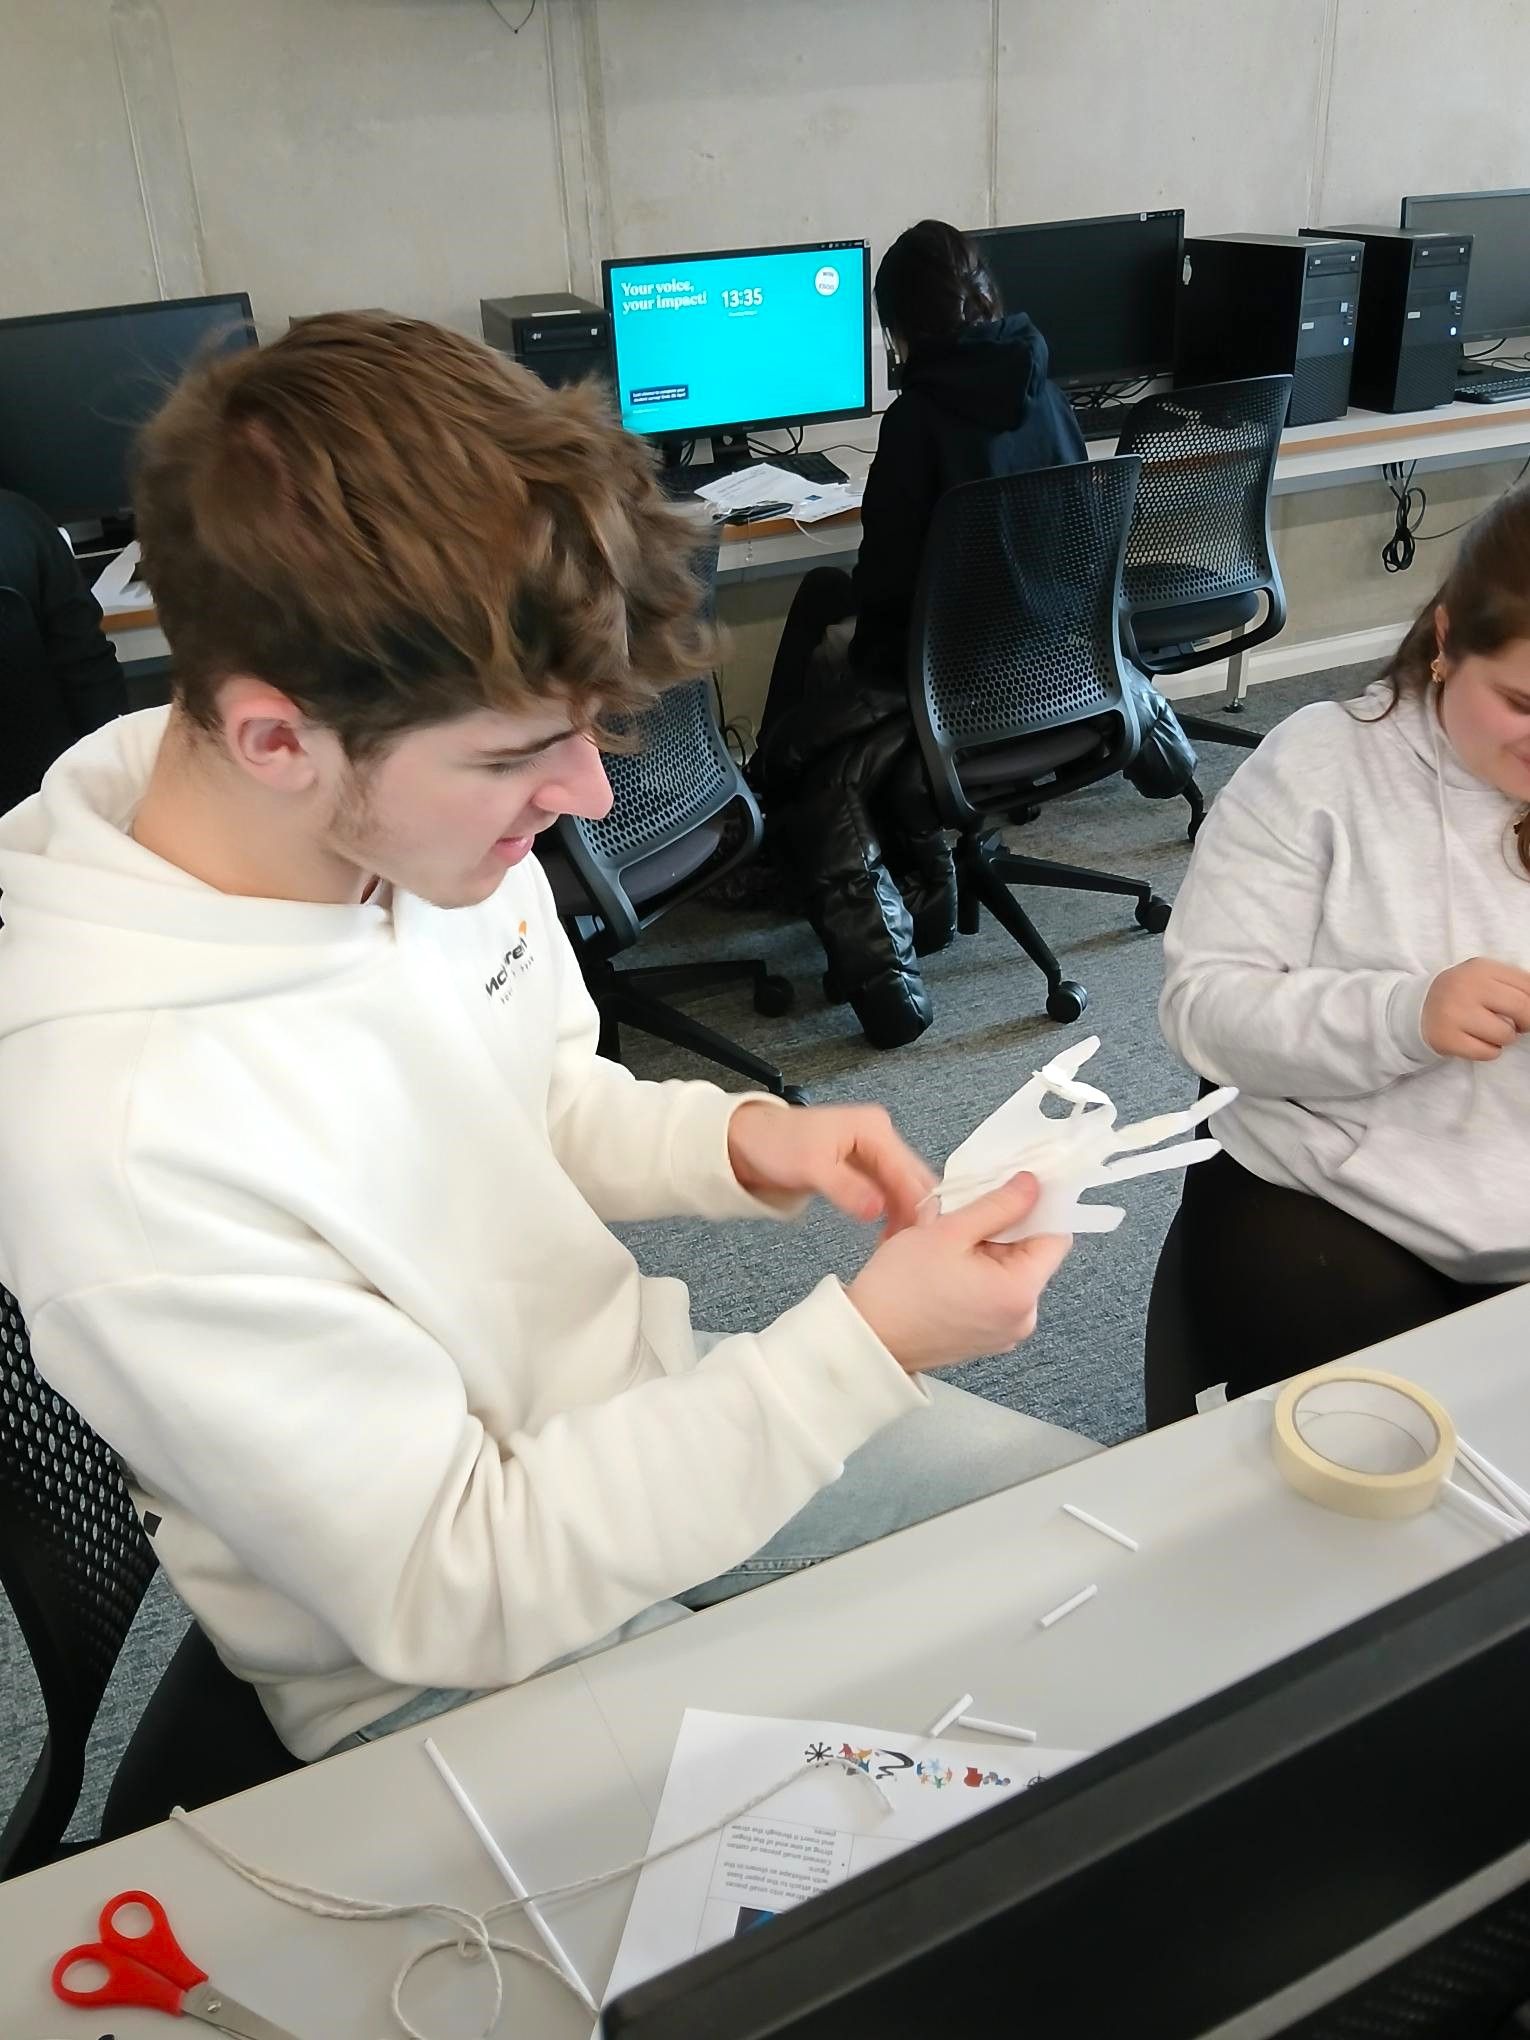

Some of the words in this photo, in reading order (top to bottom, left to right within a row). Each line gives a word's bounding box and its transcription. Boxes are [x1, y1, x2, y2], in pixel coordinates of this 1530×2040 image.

[621, 282, 654, 296] Your
[655, 278, 694, 294] voice,
[721, 287, 763, 308] 13:35
[622, 299, 655, 315] your
[656, 291, 707, 310] impact!
